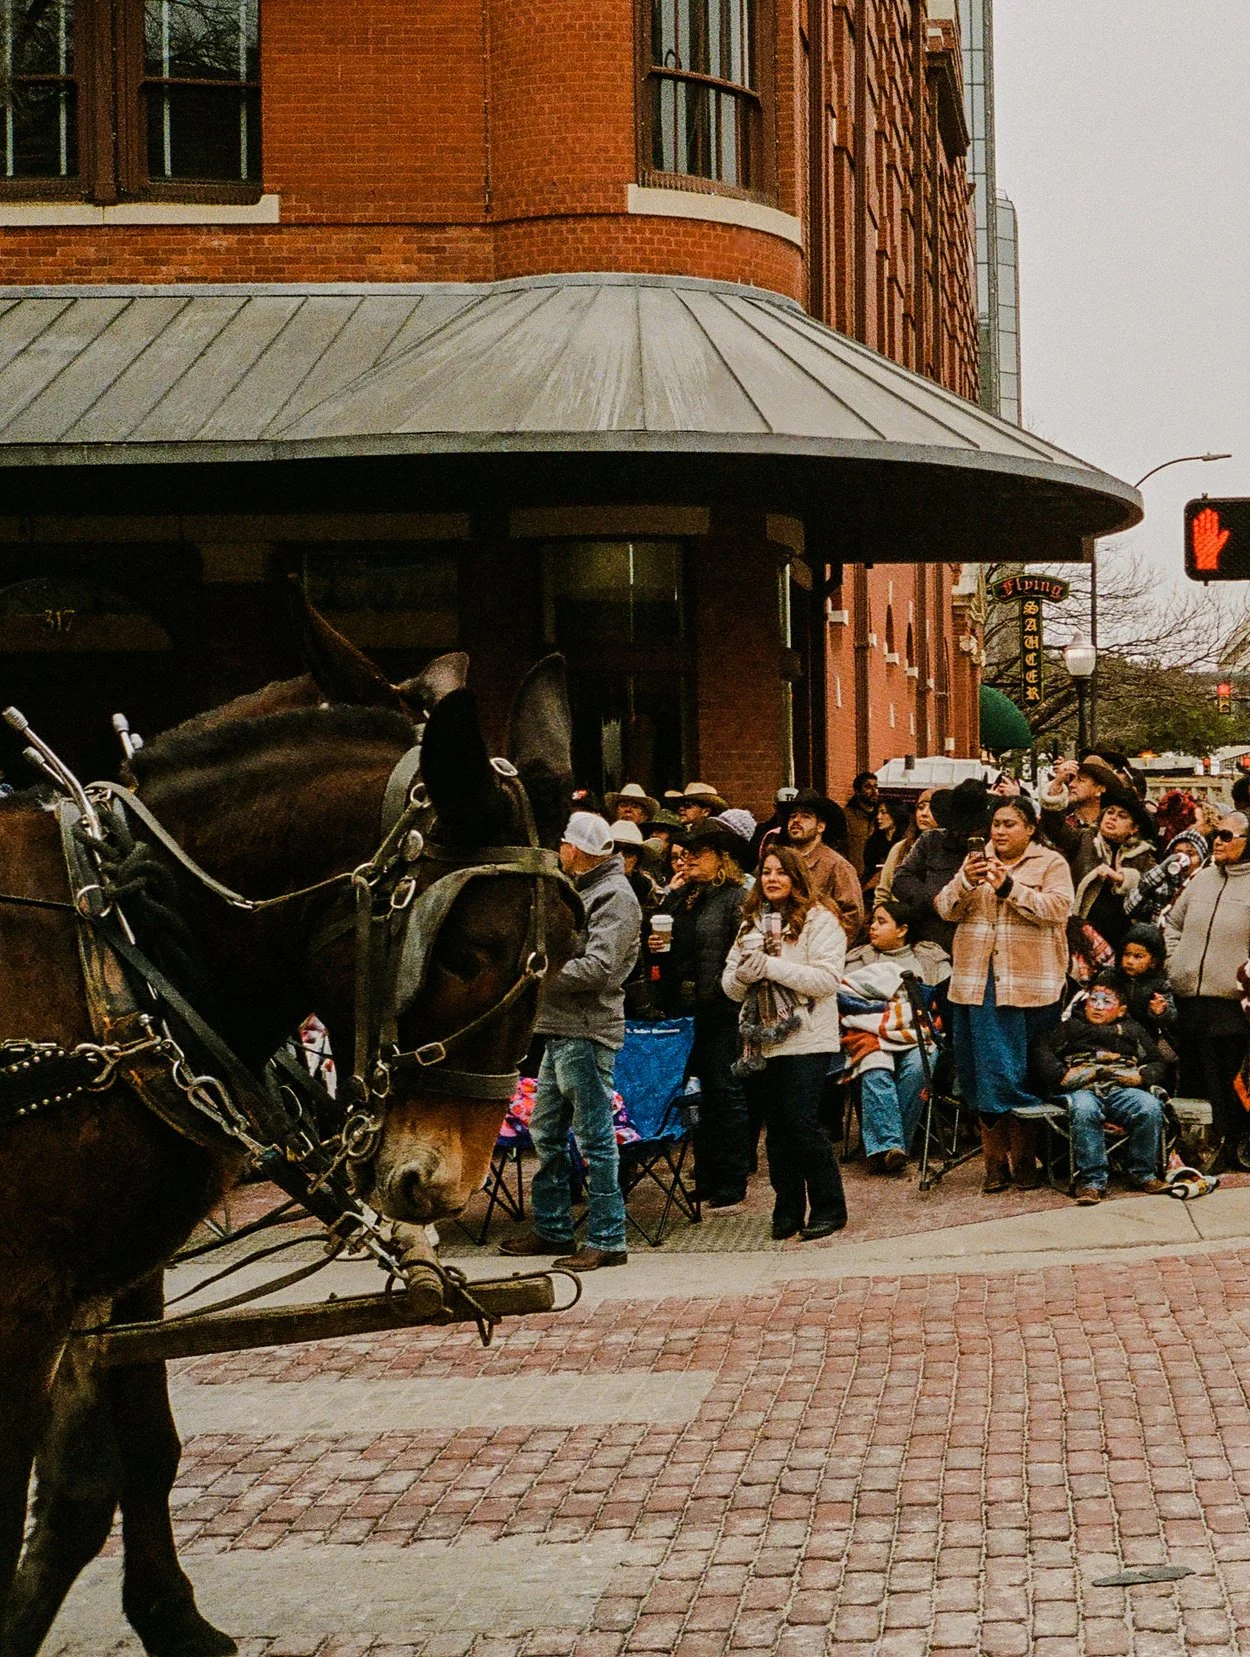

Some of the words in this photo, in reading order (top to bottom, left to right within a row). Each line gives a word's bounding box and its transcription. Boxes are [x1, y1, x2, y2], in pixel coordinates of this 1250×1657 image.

[1001, 577, 1064, 599] Flying
[43, 608, 76, 632] 317
[1023, 600, 1041, 701] SAUCER
